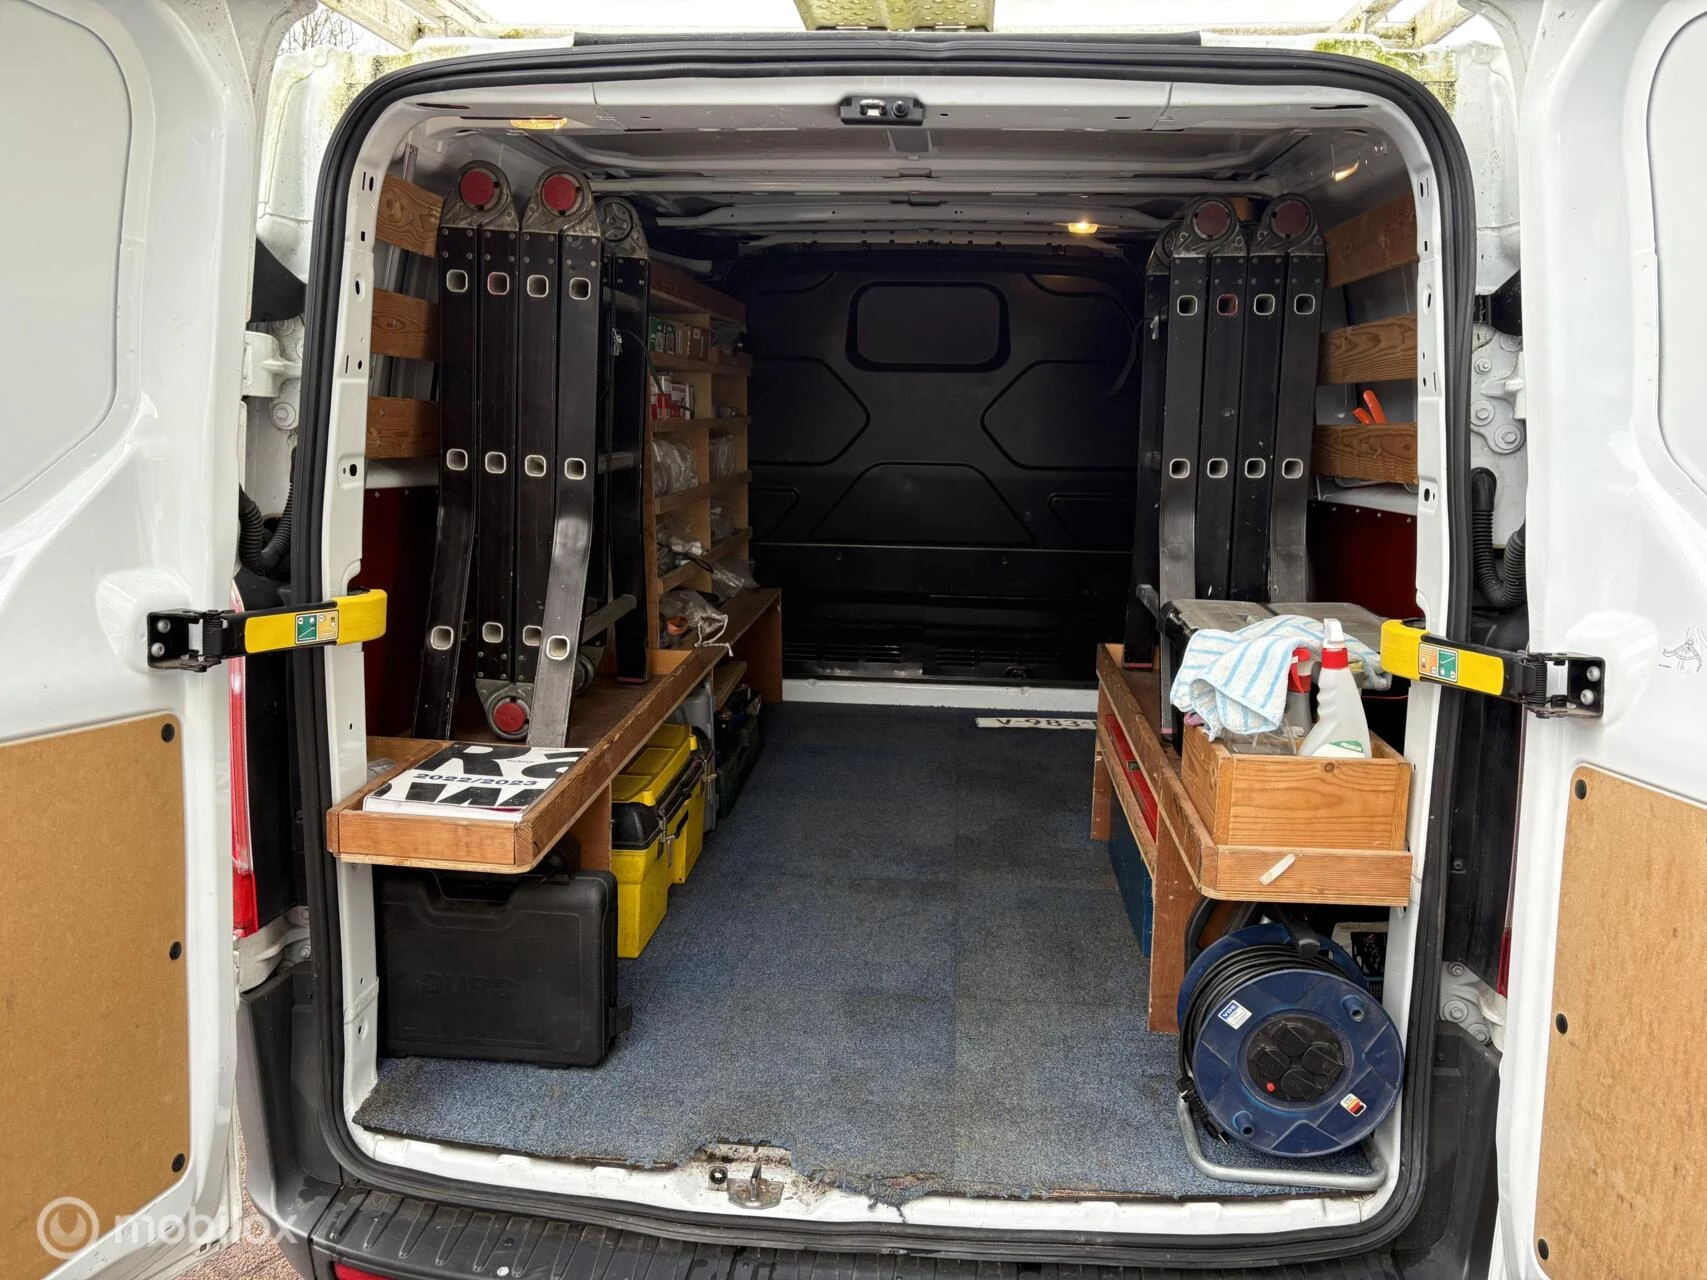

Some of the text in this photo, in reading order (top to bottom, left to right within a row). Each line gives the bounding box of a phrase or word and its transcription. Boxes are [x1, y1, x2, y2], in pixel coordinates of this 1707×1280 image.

[995, 718, 1098, 727] V-983-
[413, 773, 538, 786] 2022/2023
[1222, 1003, 1237, 1017] VDE
